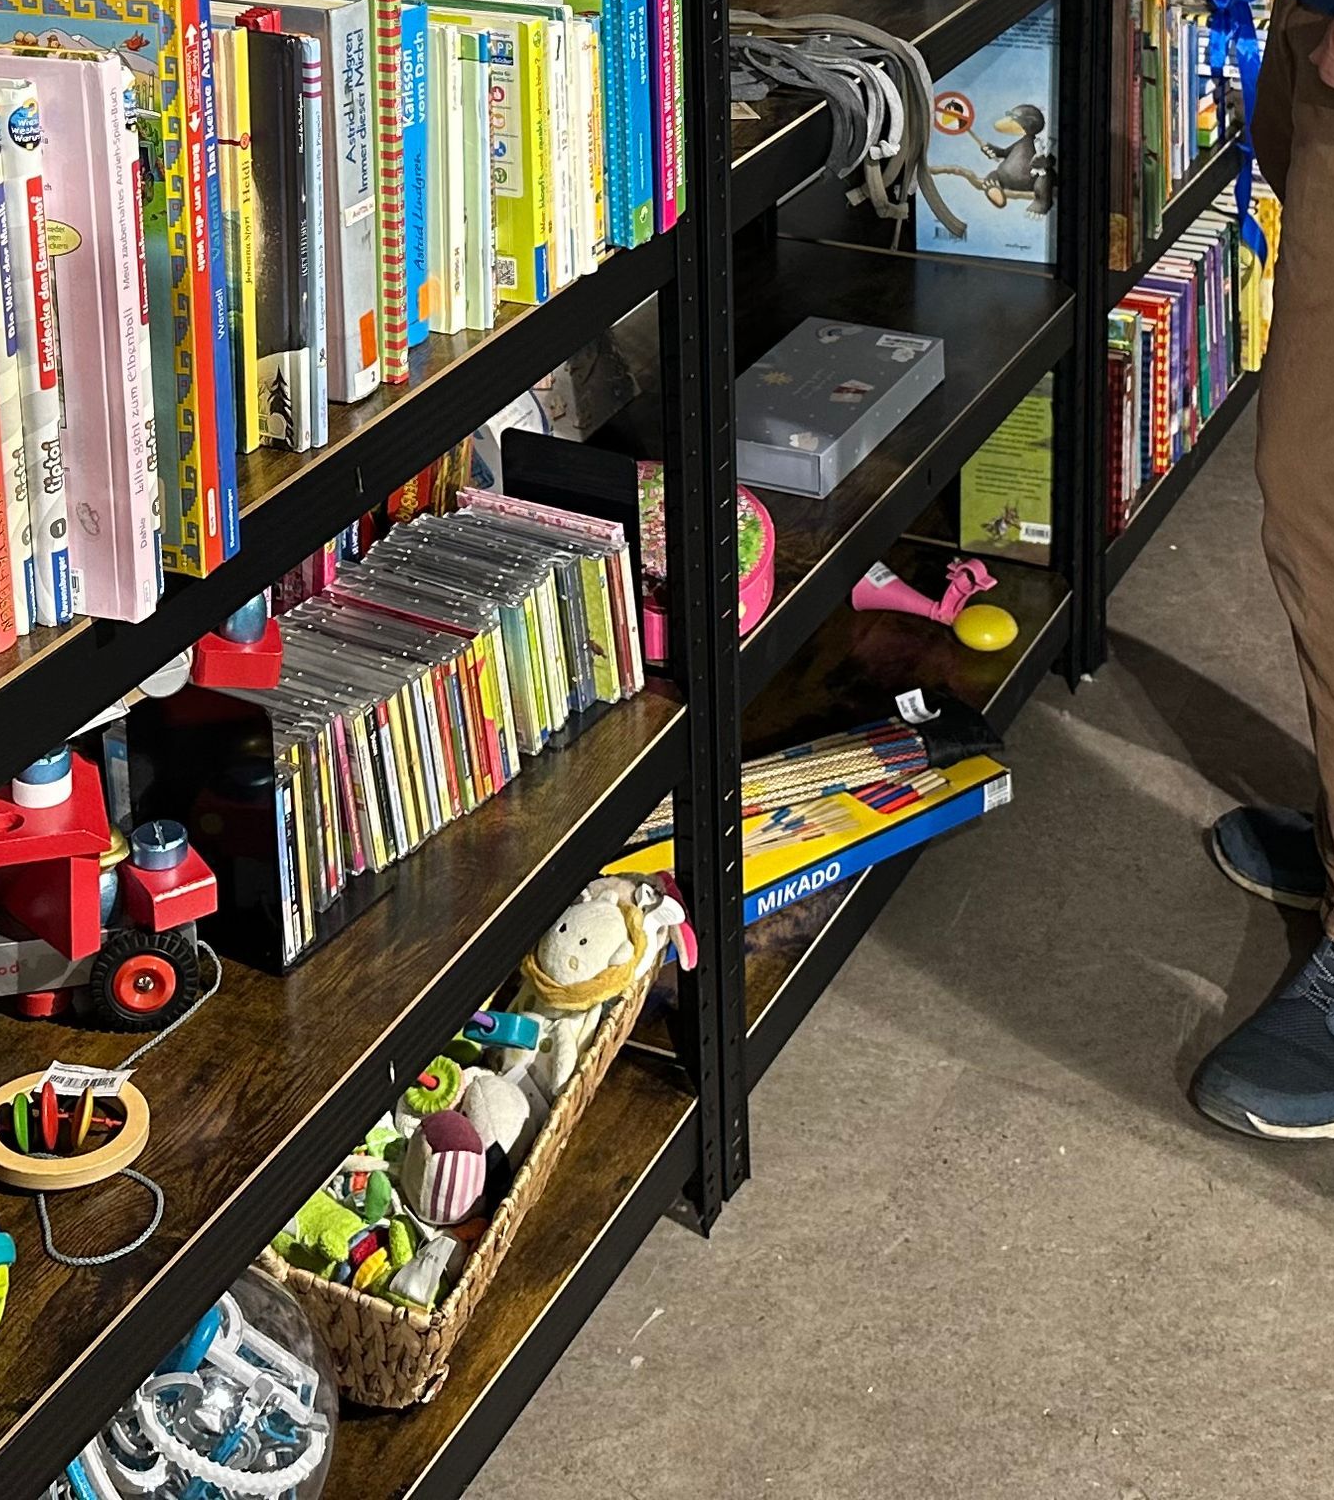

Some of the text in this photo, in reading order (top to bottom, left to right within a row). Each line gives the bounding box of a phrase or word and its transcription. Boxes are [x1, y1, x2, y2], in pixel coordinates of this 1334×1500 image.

[629, 36, 638, 61] Zoo
[637, 4, 647, 85] Puzzlebuch
[342, 32, 358, 164] Astrid Lindgren
[401, 49, 415, 128] Karlsson
[413, 31, 426, 123] vom Dach
[353, 28, 369, 193] Immer dieser Michel
[663, 110, 674, 166] lustiges
[673, 99, 683, 151] lustiges
[196, 19, 221, 261] Valentin hat keine Angst
[109, 86, 132, 290] Mein zauberhaftes Anzieh-Spiel-Buch
[241, 159, 252, 204] Heidi
[537, 173, 546, 209] klopft
[665, 167, 675, 201] Mein
[675, 154, 684, 187] Mein
[192, 143, 207, 272] Reise um die Welt
[410, 148, 426, 272] Astrid Lindgren
[2, 245, 13, 273] der
[242, 216, 253, 285] Johanna Spyri
[4, 272, 16, 311] Welt
[30, 196, 54, 373] Entdecke den Bauernhof
[6, 313, 17, 341] Die
[214, 288, 226, 340] Wensell
[123, 306, 138, 382] Elbenball
[129, 386, 139, 418] zum
[43, 436, 65, 496] tiptoi
[132, 422, 145, 457] geht
[60, 554, 70, 621] Ravensburger
[756, 861, 841, 917] MIKADO
